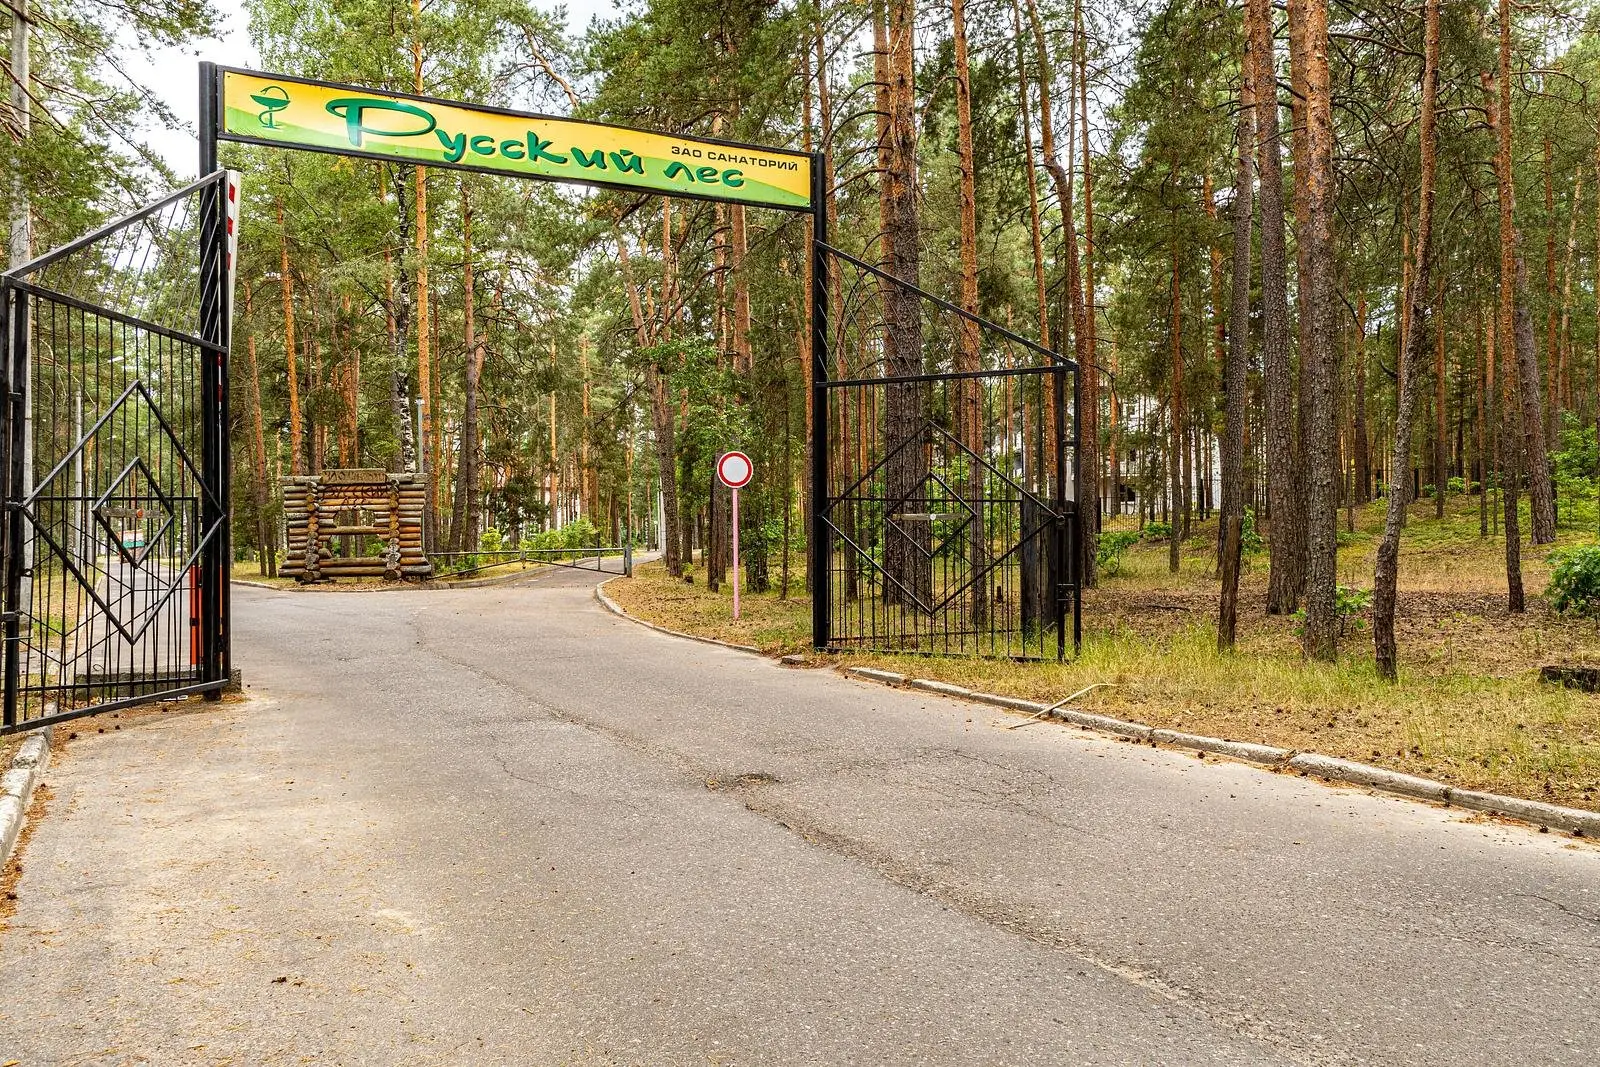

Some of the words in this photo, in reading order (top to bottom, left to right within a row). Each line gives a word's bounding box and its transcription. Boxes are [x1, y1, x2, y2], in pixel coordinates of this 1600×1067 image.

[326, 98, 644, 174] Русский
[663, 161, 744, 187] лес
[671, 145, 702, 158] ЗАО
[707, 151, 798, 171] САНАТОРИЙ
